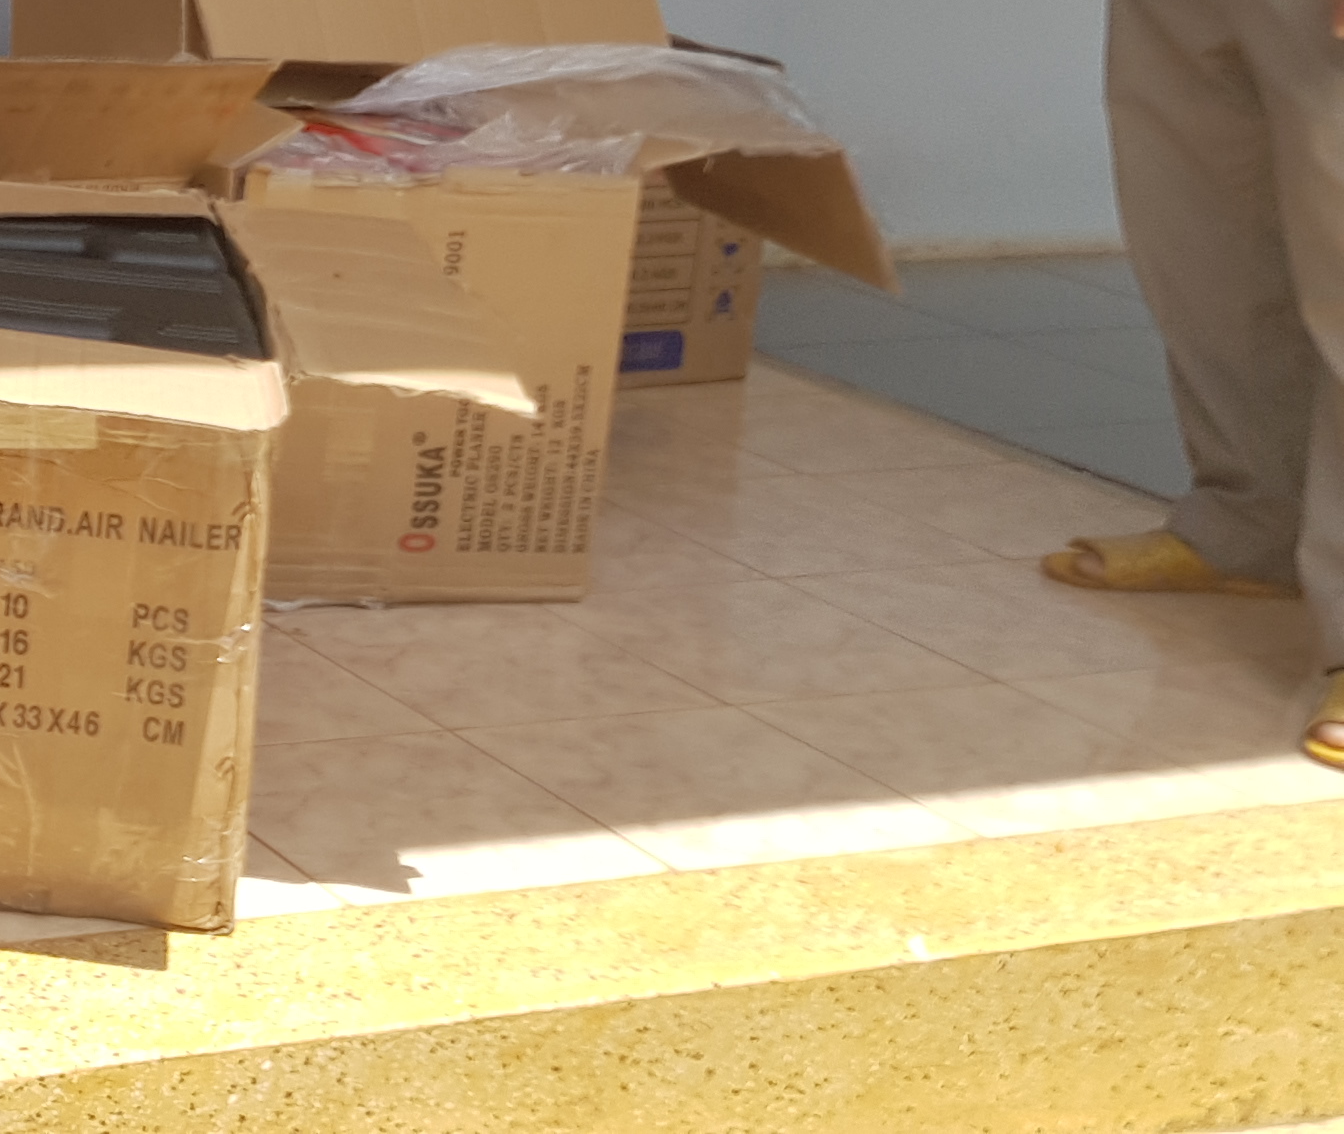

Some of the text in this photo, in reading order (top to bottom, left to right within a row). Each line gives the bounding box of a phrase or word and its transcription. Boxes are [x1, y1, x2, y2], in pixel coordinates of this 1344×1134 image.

[138, 514, 243, 552] NAILER
[477, 498, 498, 552] MODEL
[0, 592, 29, 619] 10
[131, 603, 190, 634] PCS
[127, 640, 188, 673] KGS
[124, 676, 186, 709] KGS
[13, 705, 42, 730] 33
[141, 716, 186, 747] CM
